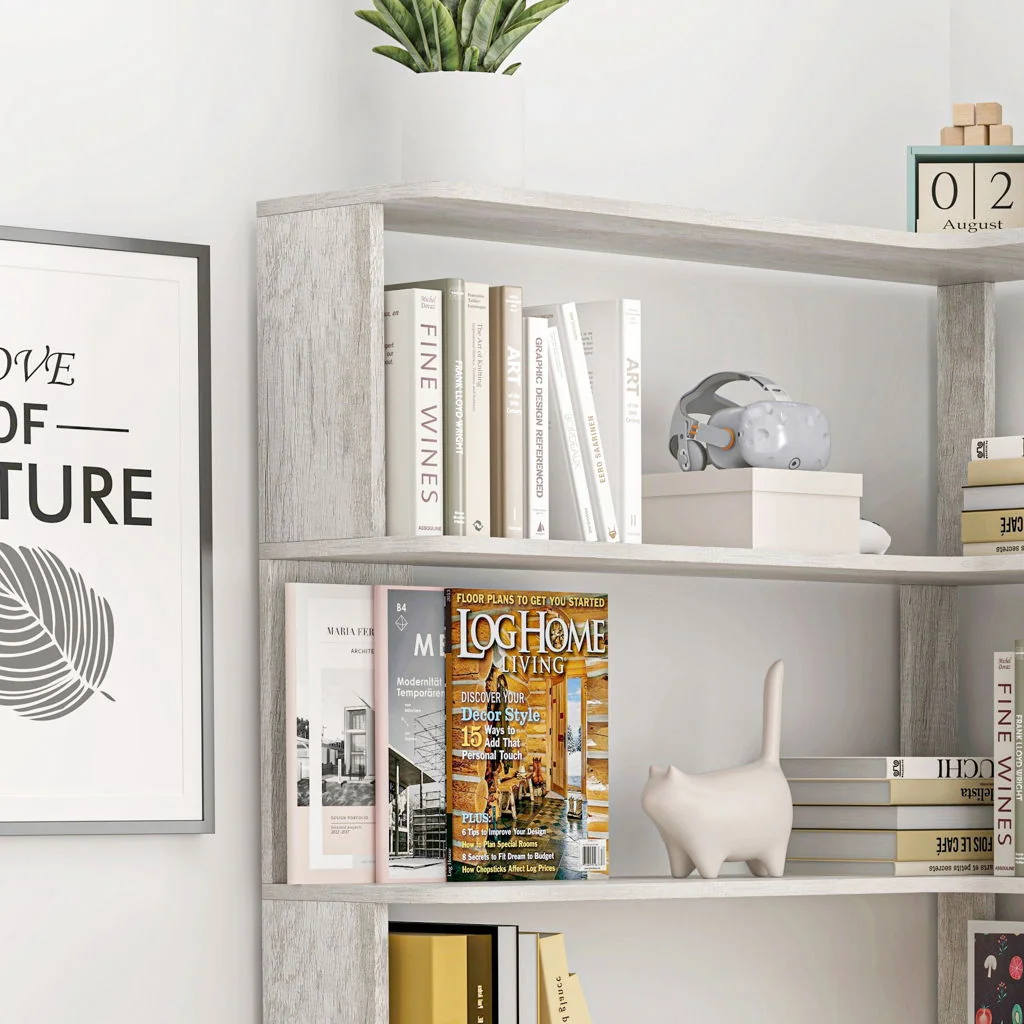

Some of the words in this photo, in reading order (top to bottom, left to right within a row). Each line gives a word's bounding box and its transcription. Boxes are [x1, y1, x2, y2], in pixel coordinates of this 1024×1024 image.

[943, 219, 1003, 233] August
[420, 323, 438, 390] FINE
[535, 337, 544, 384] GRAPHIC
[625, 358, 640, 397] ART
[535, 387, 544, 426] DESIGN
[420, 404, 439, 503] WINES
[535, 429, 544, 498] REFERENCED
[1000, 516, 1023, 536] CAFÉ
[396, 602, 407, 612] B4
[456, 592, 486, 604] FLOOR
[487, 593, 515, 605] PLANS
[517, 595, 528, 605] TO
[530, 595, 547, 606] GET
[549, 596, 566, 607] YOU
[569, 597, 605, 608] STARTED
[327, 626, 356, 636] MARIA
[501, 655, 565, 674] LIVING
[396, 676, 443, 687] Modernität
[461, 691, 501, 704] DISCOVER
[502, 692, 525, 704] YOUR
[461, 707, 502, 722] Decor
[504, 707, 541, 726] Style
[997, 683, 1012, 743] FINE
[461, 725, 483, 747] 15
[484, 725, 505, 737] Ways
[507, 726, 516, 735] to
[1015, 714, 1023, 740] FRANK
[484, 737, 500, 748] Add
[502, 737, 521, 748] That
[461, 750, 497, 760] Personal
[500, 750, 523, 760] Touch
[1015, 742, 1023, 768] LLOYD
[1015, 768, 1023, 802] WRIGHT
[997, 756, 1012, 846] WINES
[461, 813, 491, 824] PLUS:
[488, 828, 511, 836] Improve
[513, 828, 526, 836] Your
[527, 828, 547, 837] Design
[497, 841, 517, 849] Special
[468, 853, 489, 861] Secrets
[491, 853, 497, 861] to
[534, 852, 555, 861] Budget
[461, 865, 475, 874] How
[526, 864, 537, 873] Log
[537, 864, 556, 872] Prices
